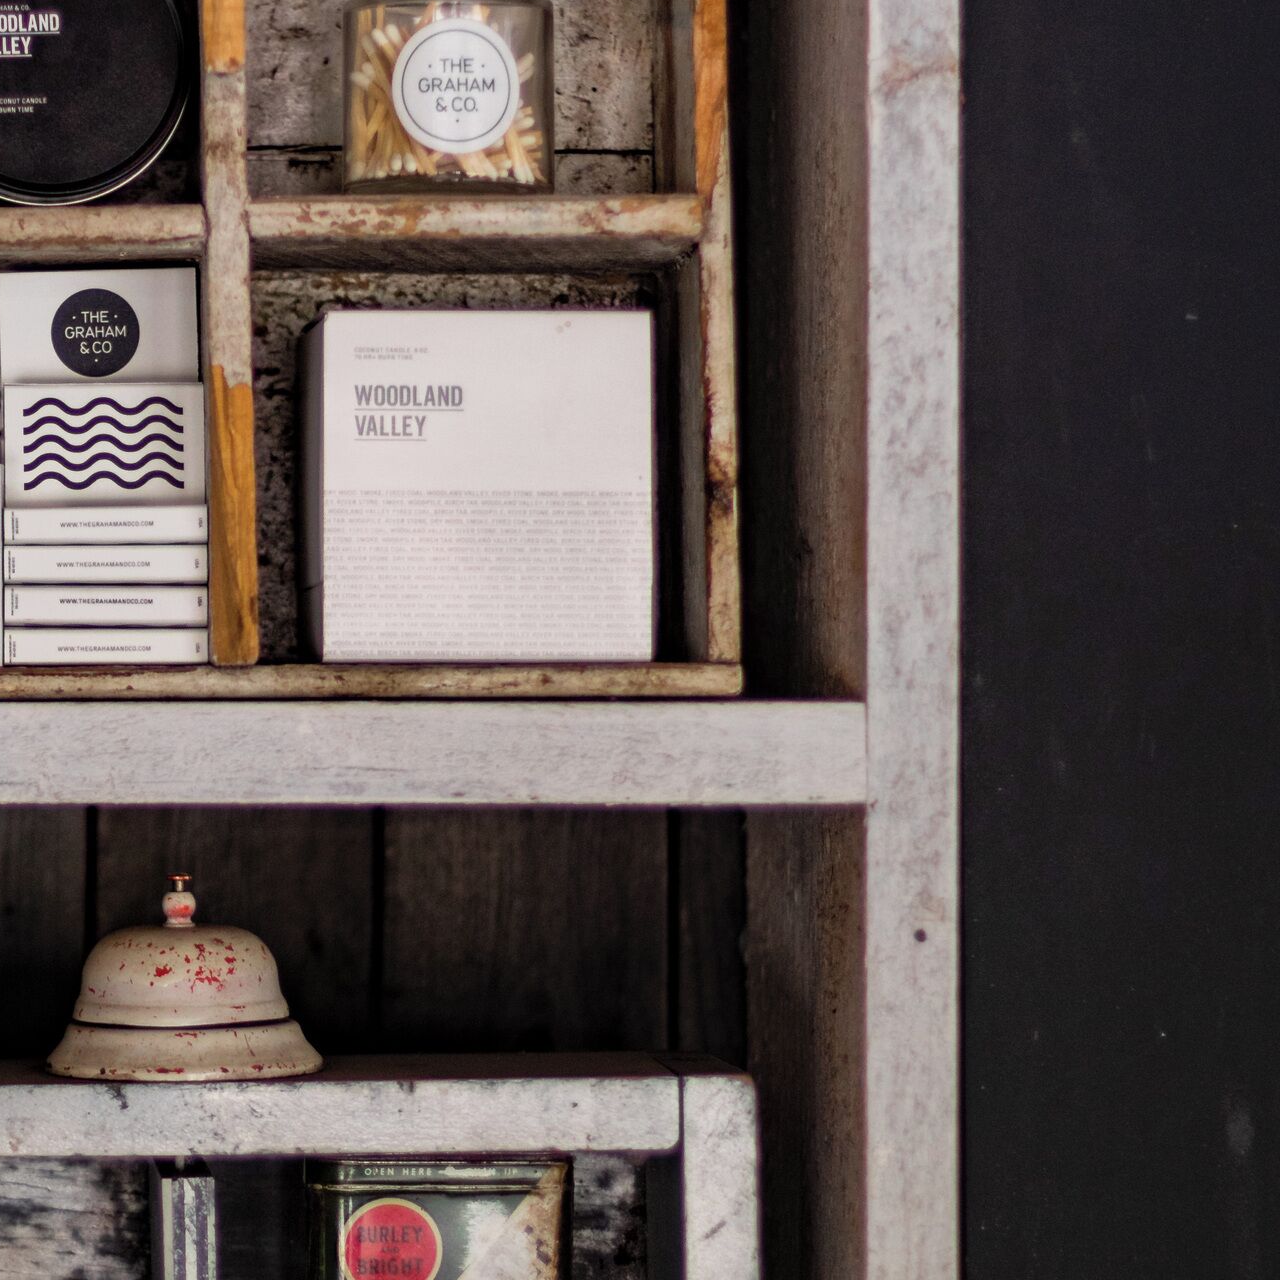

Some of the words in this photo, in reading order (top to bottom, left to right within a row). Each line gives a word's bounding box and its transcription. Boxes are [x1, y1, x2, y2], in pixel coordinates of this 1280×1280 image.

[440, 58, 474, 73] THE
[418, 77, 495, 93] GRAHAM
[436, 97, 447, 112] &
[452, 97, 478, 112] CO.
[81, 311, 109, 323] THE
[65, 325, 127, 339] GRAHAM
[80, 341, 90, 354] &
[92, 341, 112, 354] CO
[354, 384, 463, 407] WOODLAND
[354, 415, 426, 436] VALLEY
[358, 1226, 423, 1243] BURLEY
[358, 1257, 423, 1275] BRIGHT
